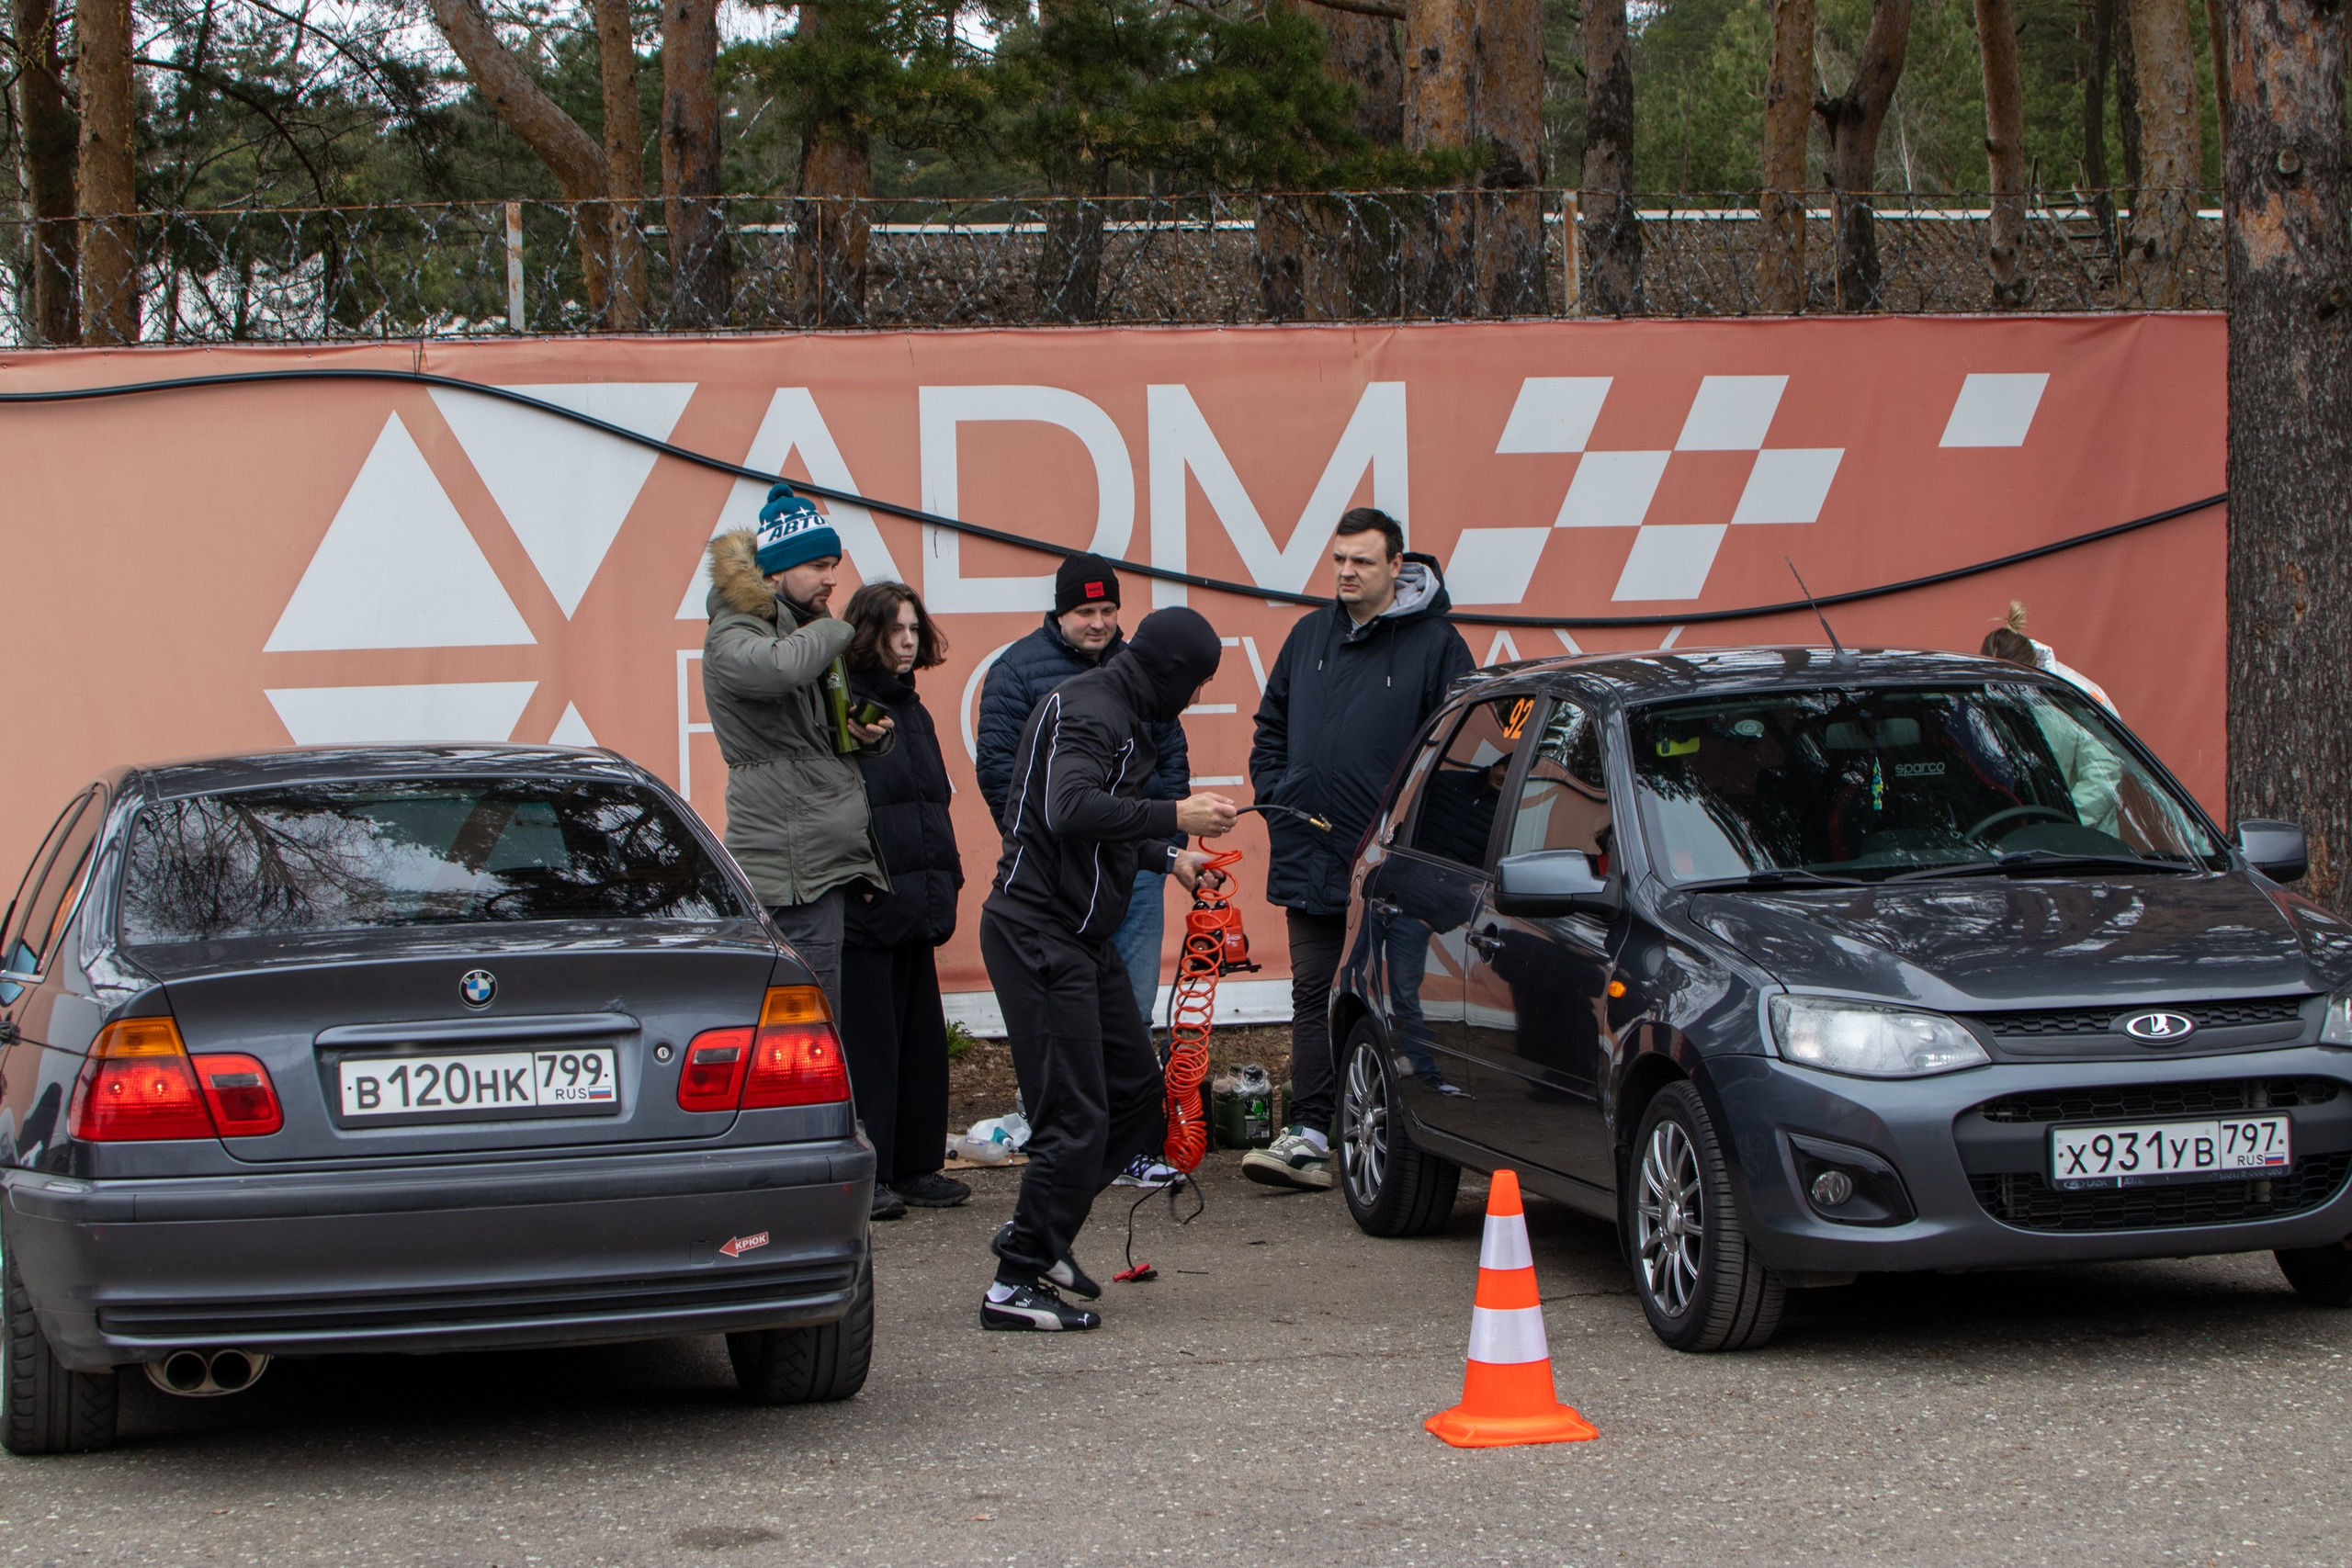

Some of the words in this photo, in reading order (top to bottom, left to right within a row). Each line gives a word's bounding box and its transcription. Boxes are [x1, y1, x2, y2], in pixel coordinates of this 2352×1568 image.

[675, 381, 1410, 620] ADM
[768, 515, 826, 542] АВТО
[1503, 698, 1534, 739] 92
[1895, 761, 1945, 777] sparco
[463, 972, 494, 985] BMW
[356, 1062, 530, 1110] В120НК
[537, 1054, 603, 1088] 799
[555, 1088, 587, 1100] RUS
[2066, 1130, 2214, 1175] Х931УВ
[2222, 1122, 2278, 1155] 797
[2237, 1153, 2264, 1167] RUS
[735, 1235, 766, 1250] КРЮК
